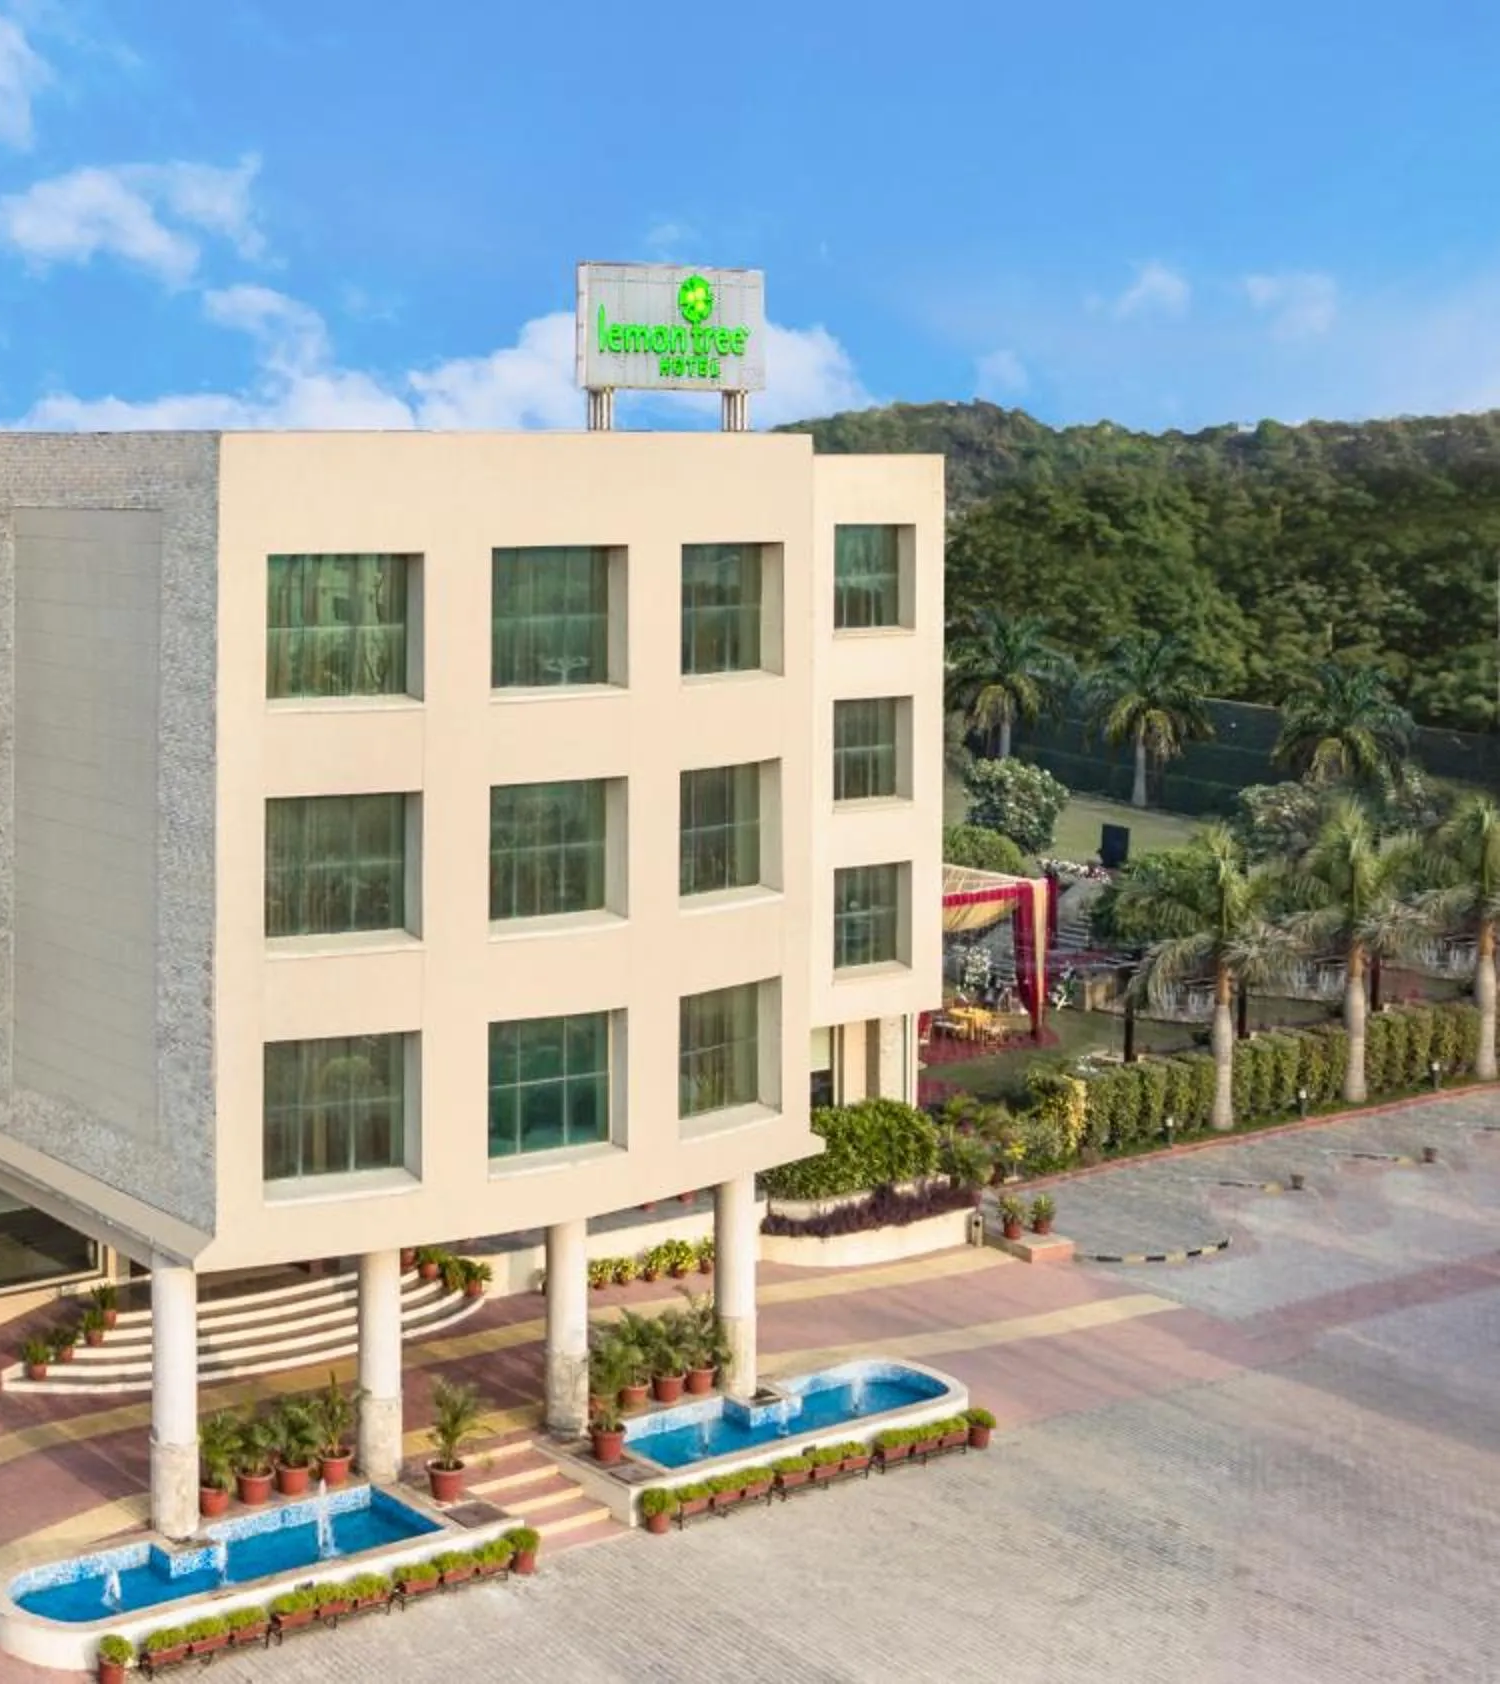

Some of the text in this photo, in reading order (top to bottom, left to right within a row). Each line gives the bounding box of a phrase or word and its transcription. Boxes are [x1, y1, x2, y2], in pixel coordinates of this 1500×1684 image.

[597, 303, 751, 356] lemon tree
[658, 356, 722, 379] HOTEL
